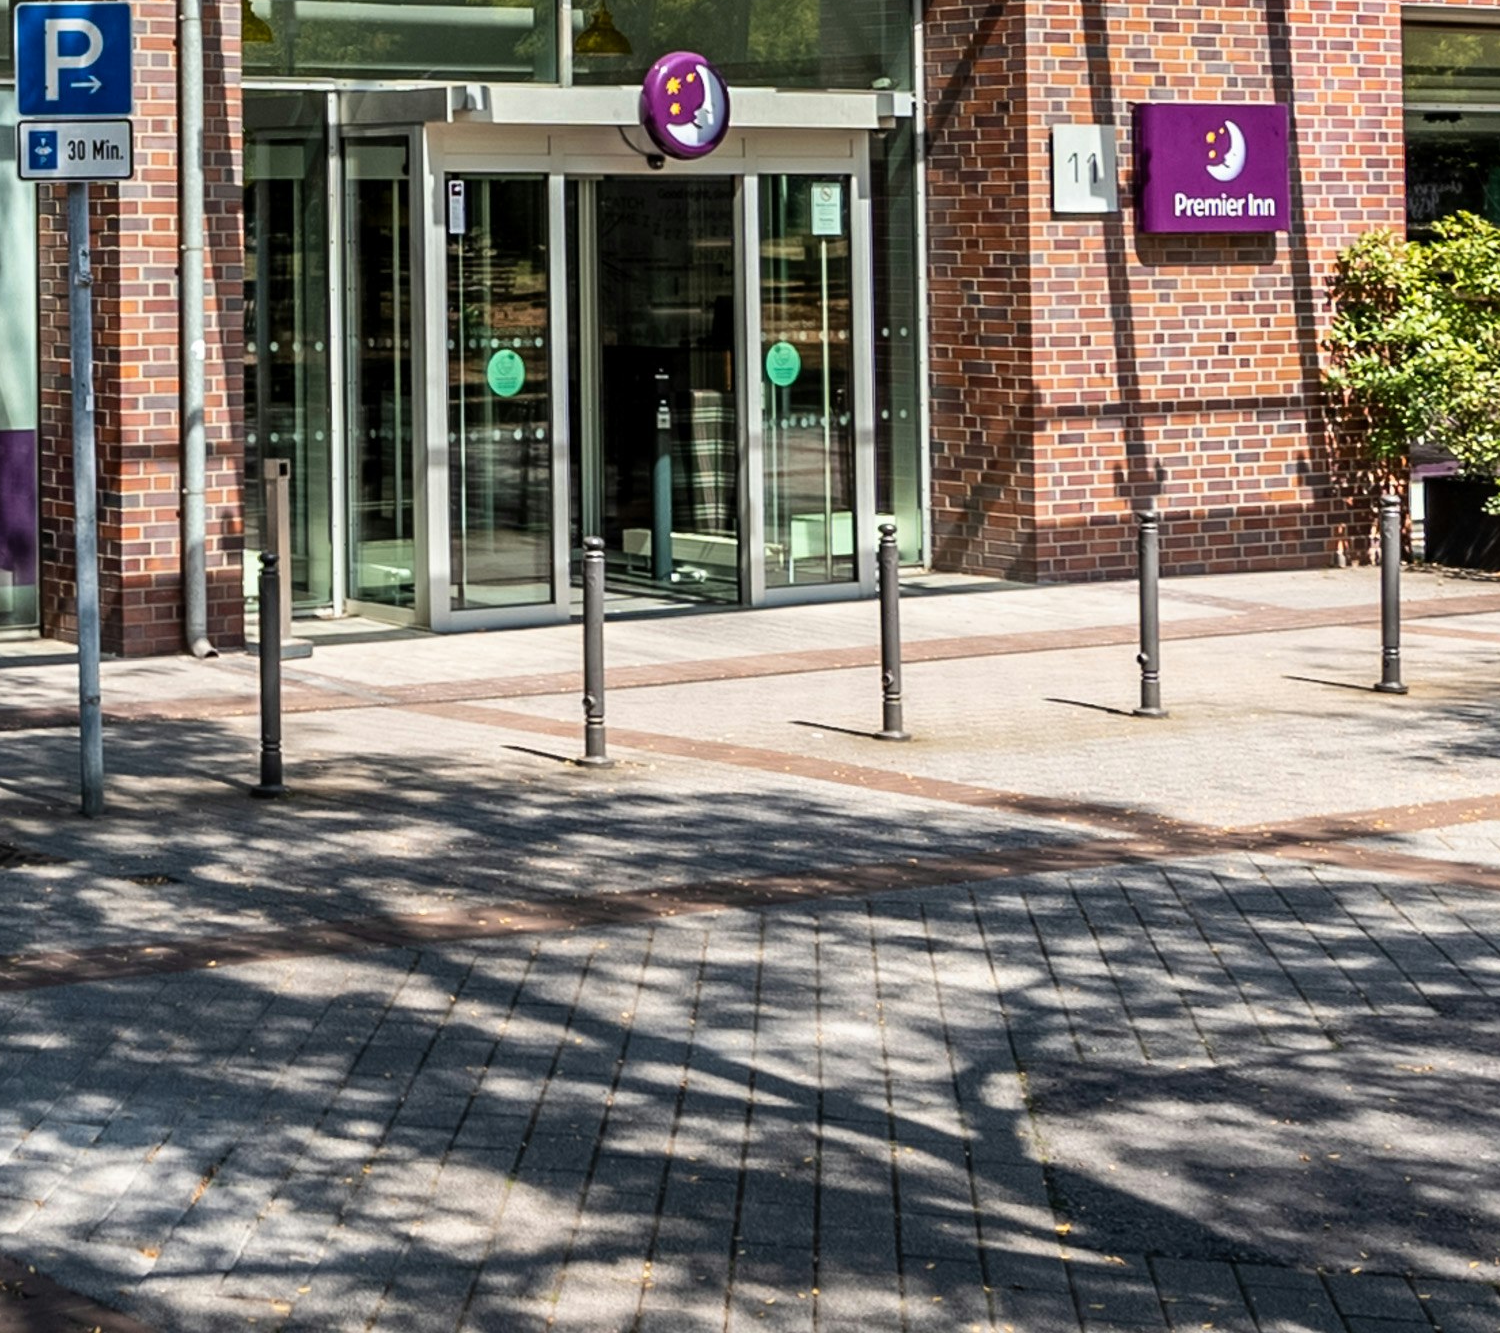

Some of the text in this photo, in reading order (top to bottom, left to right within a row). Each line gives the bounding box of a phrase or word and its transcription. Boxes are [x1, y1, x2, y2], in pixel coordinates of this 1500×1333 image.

[45, 18, 104, 101] P
[67, 139, 125, 161] 30 Min.
[1067, 152, 1099, 183] 11
[1174, 192, 1276, 217] Premier Inn
